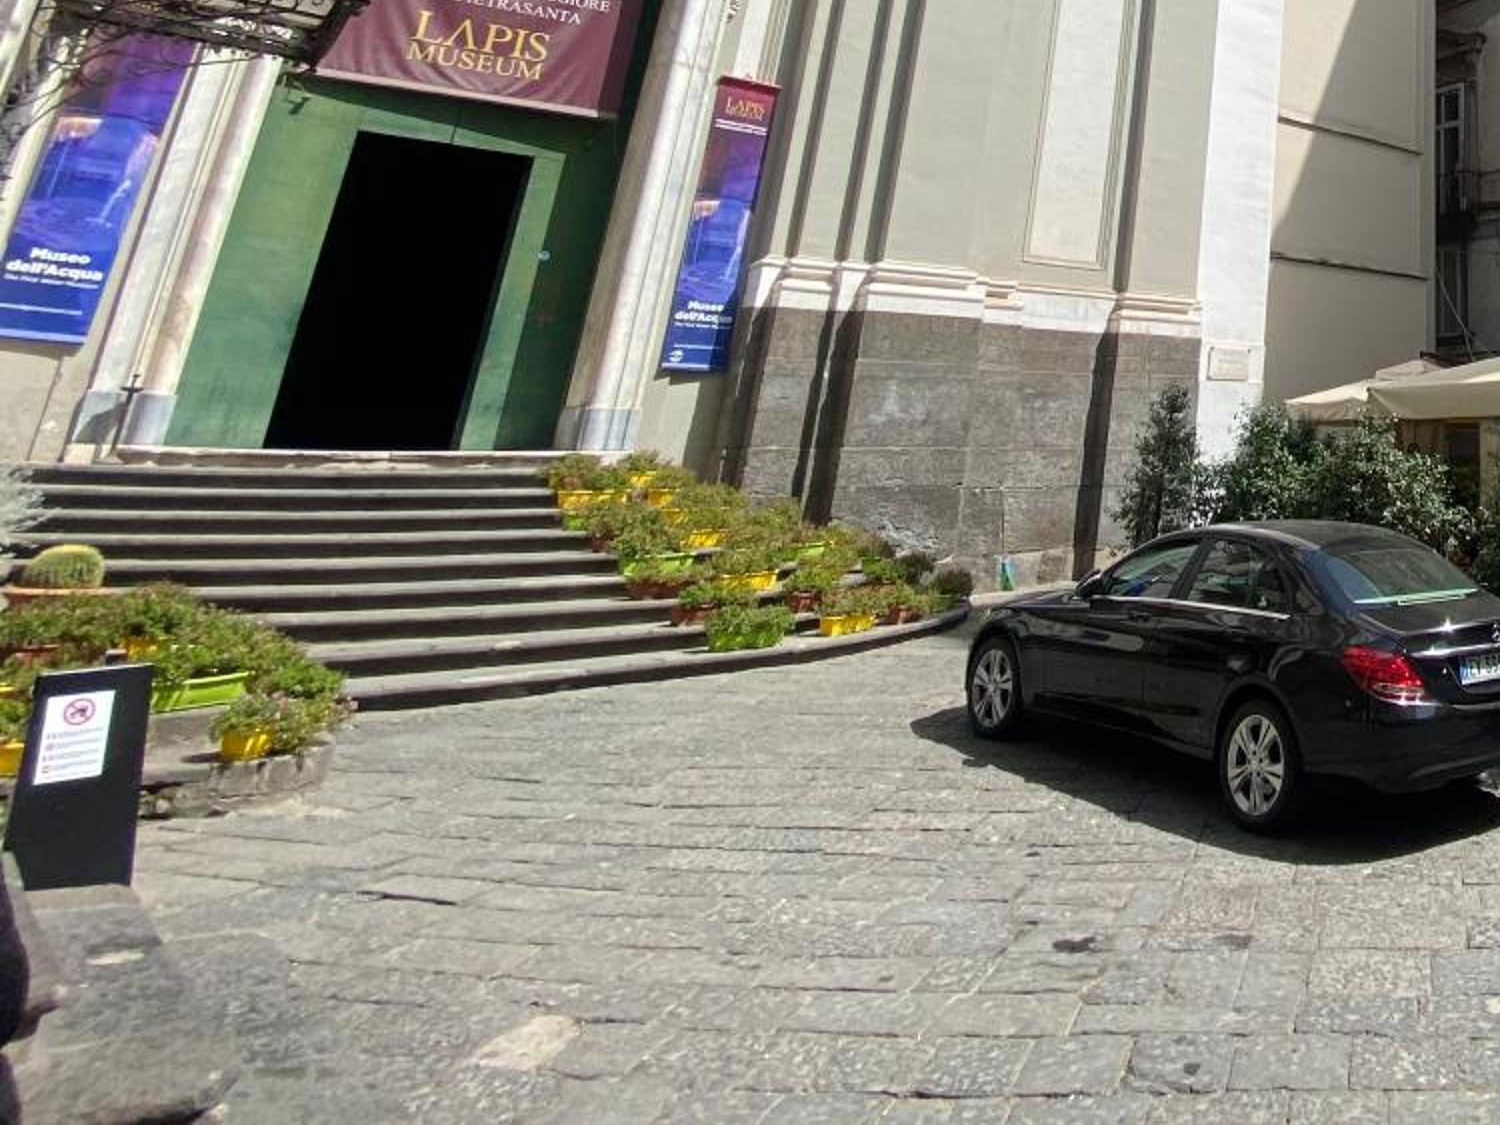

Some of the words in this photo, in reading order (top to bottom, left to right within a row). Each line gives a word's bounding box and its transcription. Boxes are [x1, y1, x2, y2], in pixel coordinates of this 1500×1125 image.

[408, 10, 551, 63] LAPIS
[405, 40, 544, 81] MUSEUM
[5, 259, 103, 283] dell'Acqua
[29, 246, 92, 265] Museo
